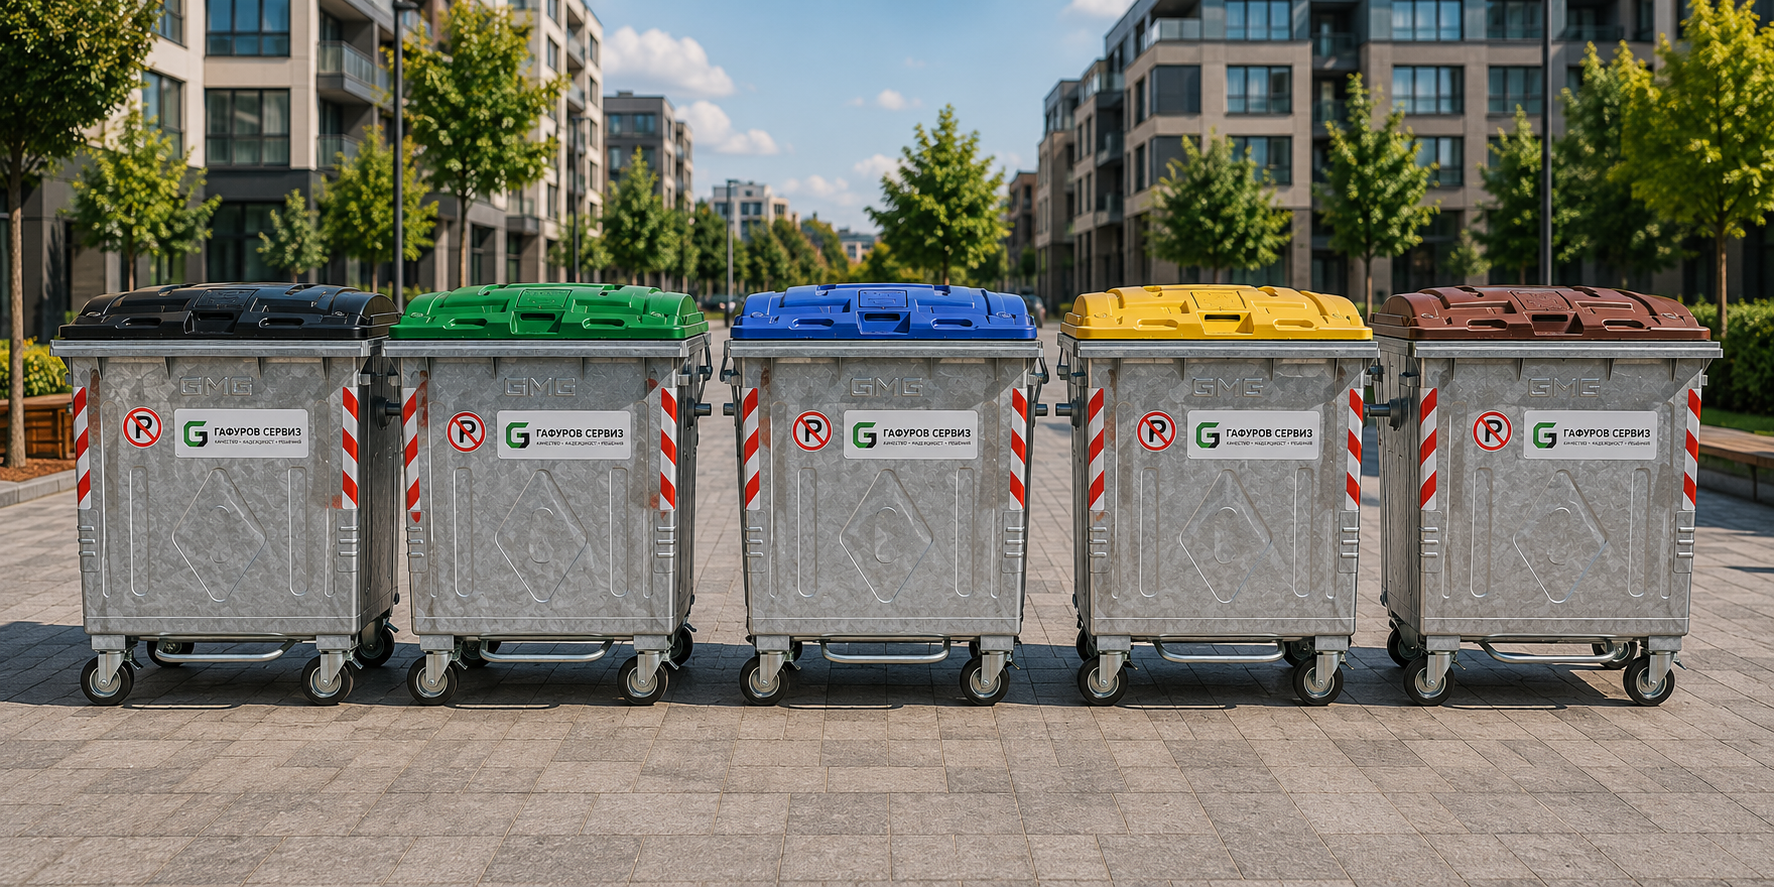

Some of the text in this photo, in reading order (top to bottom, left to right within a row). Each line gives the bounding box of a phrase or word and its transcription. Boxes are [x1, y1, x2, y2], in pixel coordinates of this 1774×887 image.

[179, 377, 252, 396] GMG
[504, 377, 576, 396] GMG
[850, 377, 922, 397] GMG
[135, 416, 152, 438] P
[184, 421, 208, 447] G
[214, 427, 302, 436] ГАФУРОВ СЕРВИЗ
[459, 420, 476, 443] P
[506, 422, 530, 448] G
[536, 429, 624, 438] ГАФУРОВ СЕРВИЗ
[805, 420, 822, 442] P
[853, 422, 877, 448] G
[883, 429, 971, 438] ГАФУРОВ СЕРВИЗ
[1149, 420, 1166, 442] P
[1196, 422, 1220, 448] G
[1226, 429, 1313, 438] ГАФУРОВ СЕРВИЗ
[1485, 420, 1502, 442] P
[1533, 422, 1557, 449] G
[1563, 429, 1651, 438] ГАФУРОВ СЕРВИЗ
